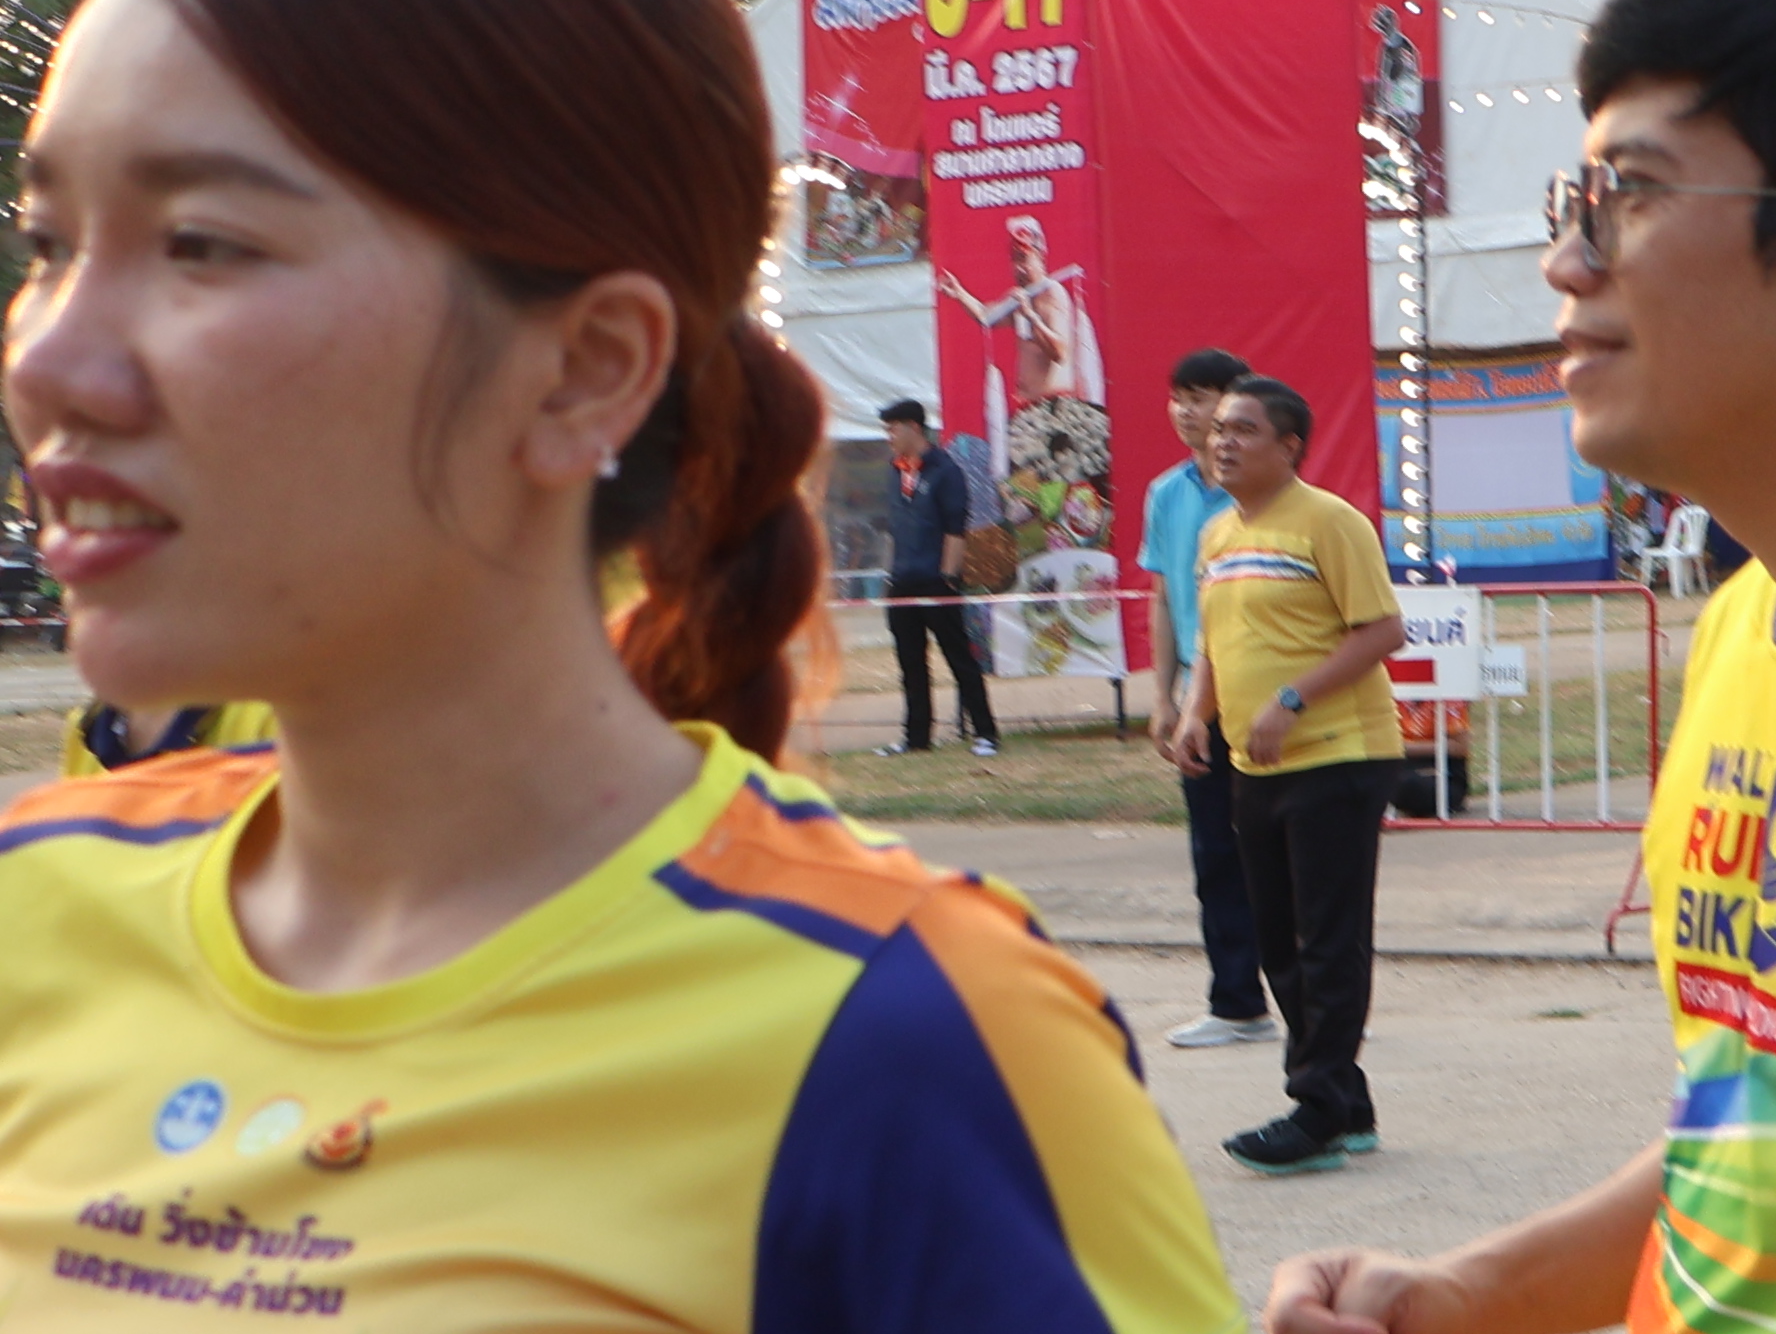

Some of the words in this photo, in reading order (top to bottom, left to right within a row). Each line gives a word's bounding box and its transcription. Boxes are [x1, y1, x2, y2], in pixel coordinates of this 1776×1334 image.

[992, 44, 1079, 94] 2567
[1704, 744, 1770, 799] WAL
[1676, 883, 1755, 962] BIK
